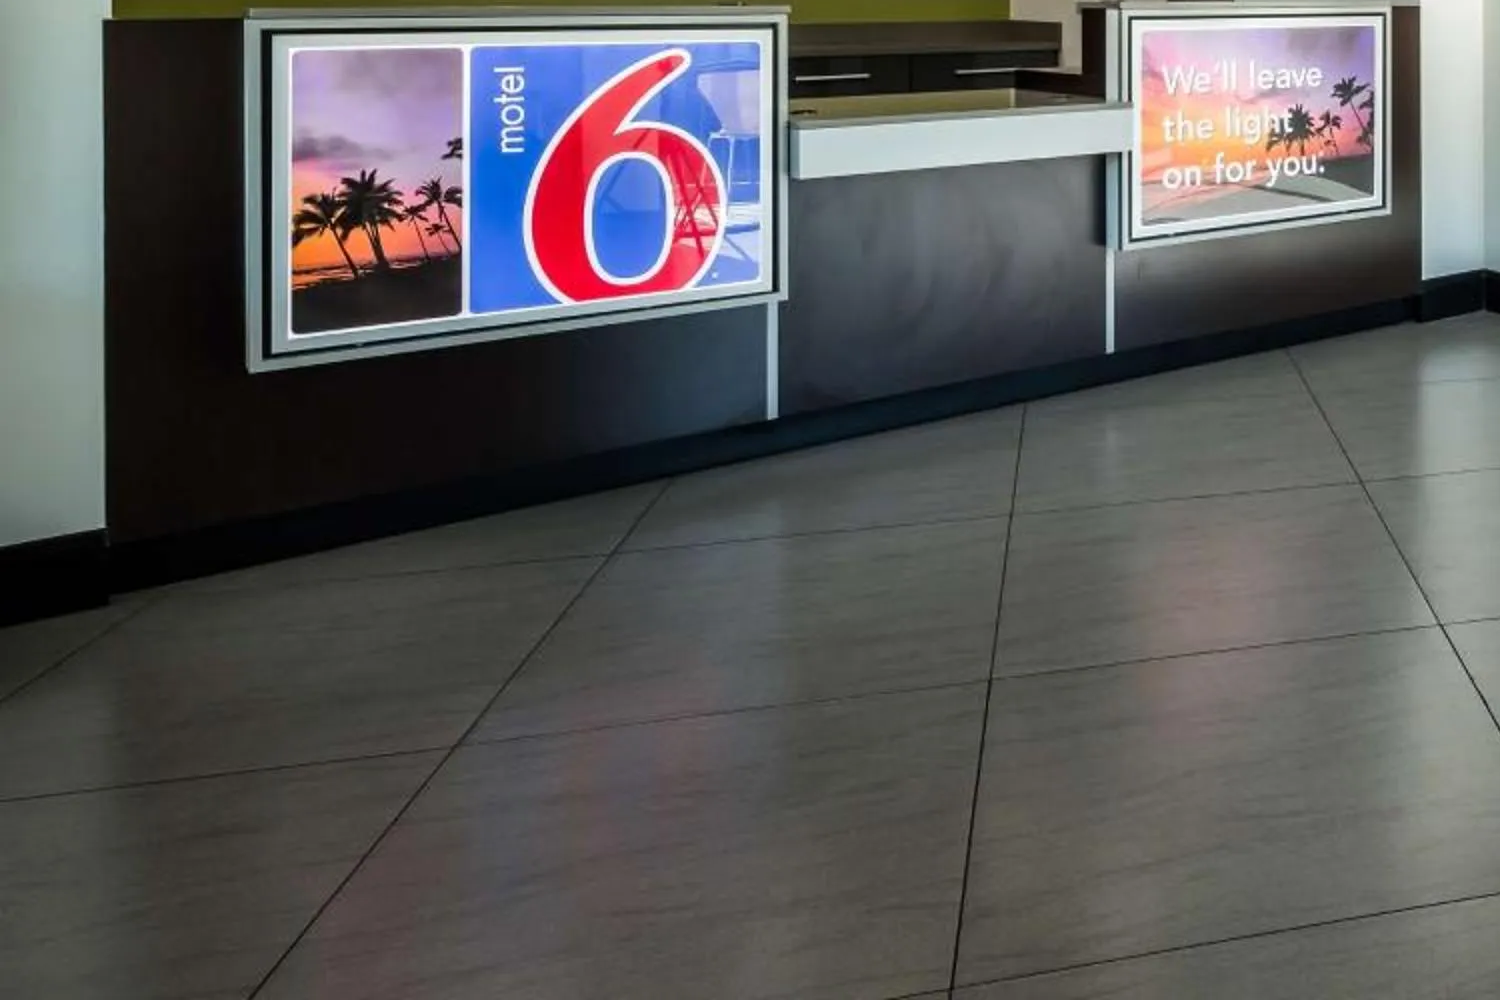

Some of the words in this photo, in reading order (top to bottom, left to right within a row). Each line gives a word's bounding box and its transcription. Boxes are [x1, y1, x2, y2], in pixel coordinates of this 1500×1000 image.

[1161, 60, 1238, 95] We'll
[1249, 60, 1323, 90] leave
[1163, 110, 1214, 142] the
[1226, 106, 1294, 144] light
[493, 67, 525, 153] motel
[522, 48, 728, 305] 6
[1162, 165, 1201, 189] on
[1214, 152, 1256, 185] for
